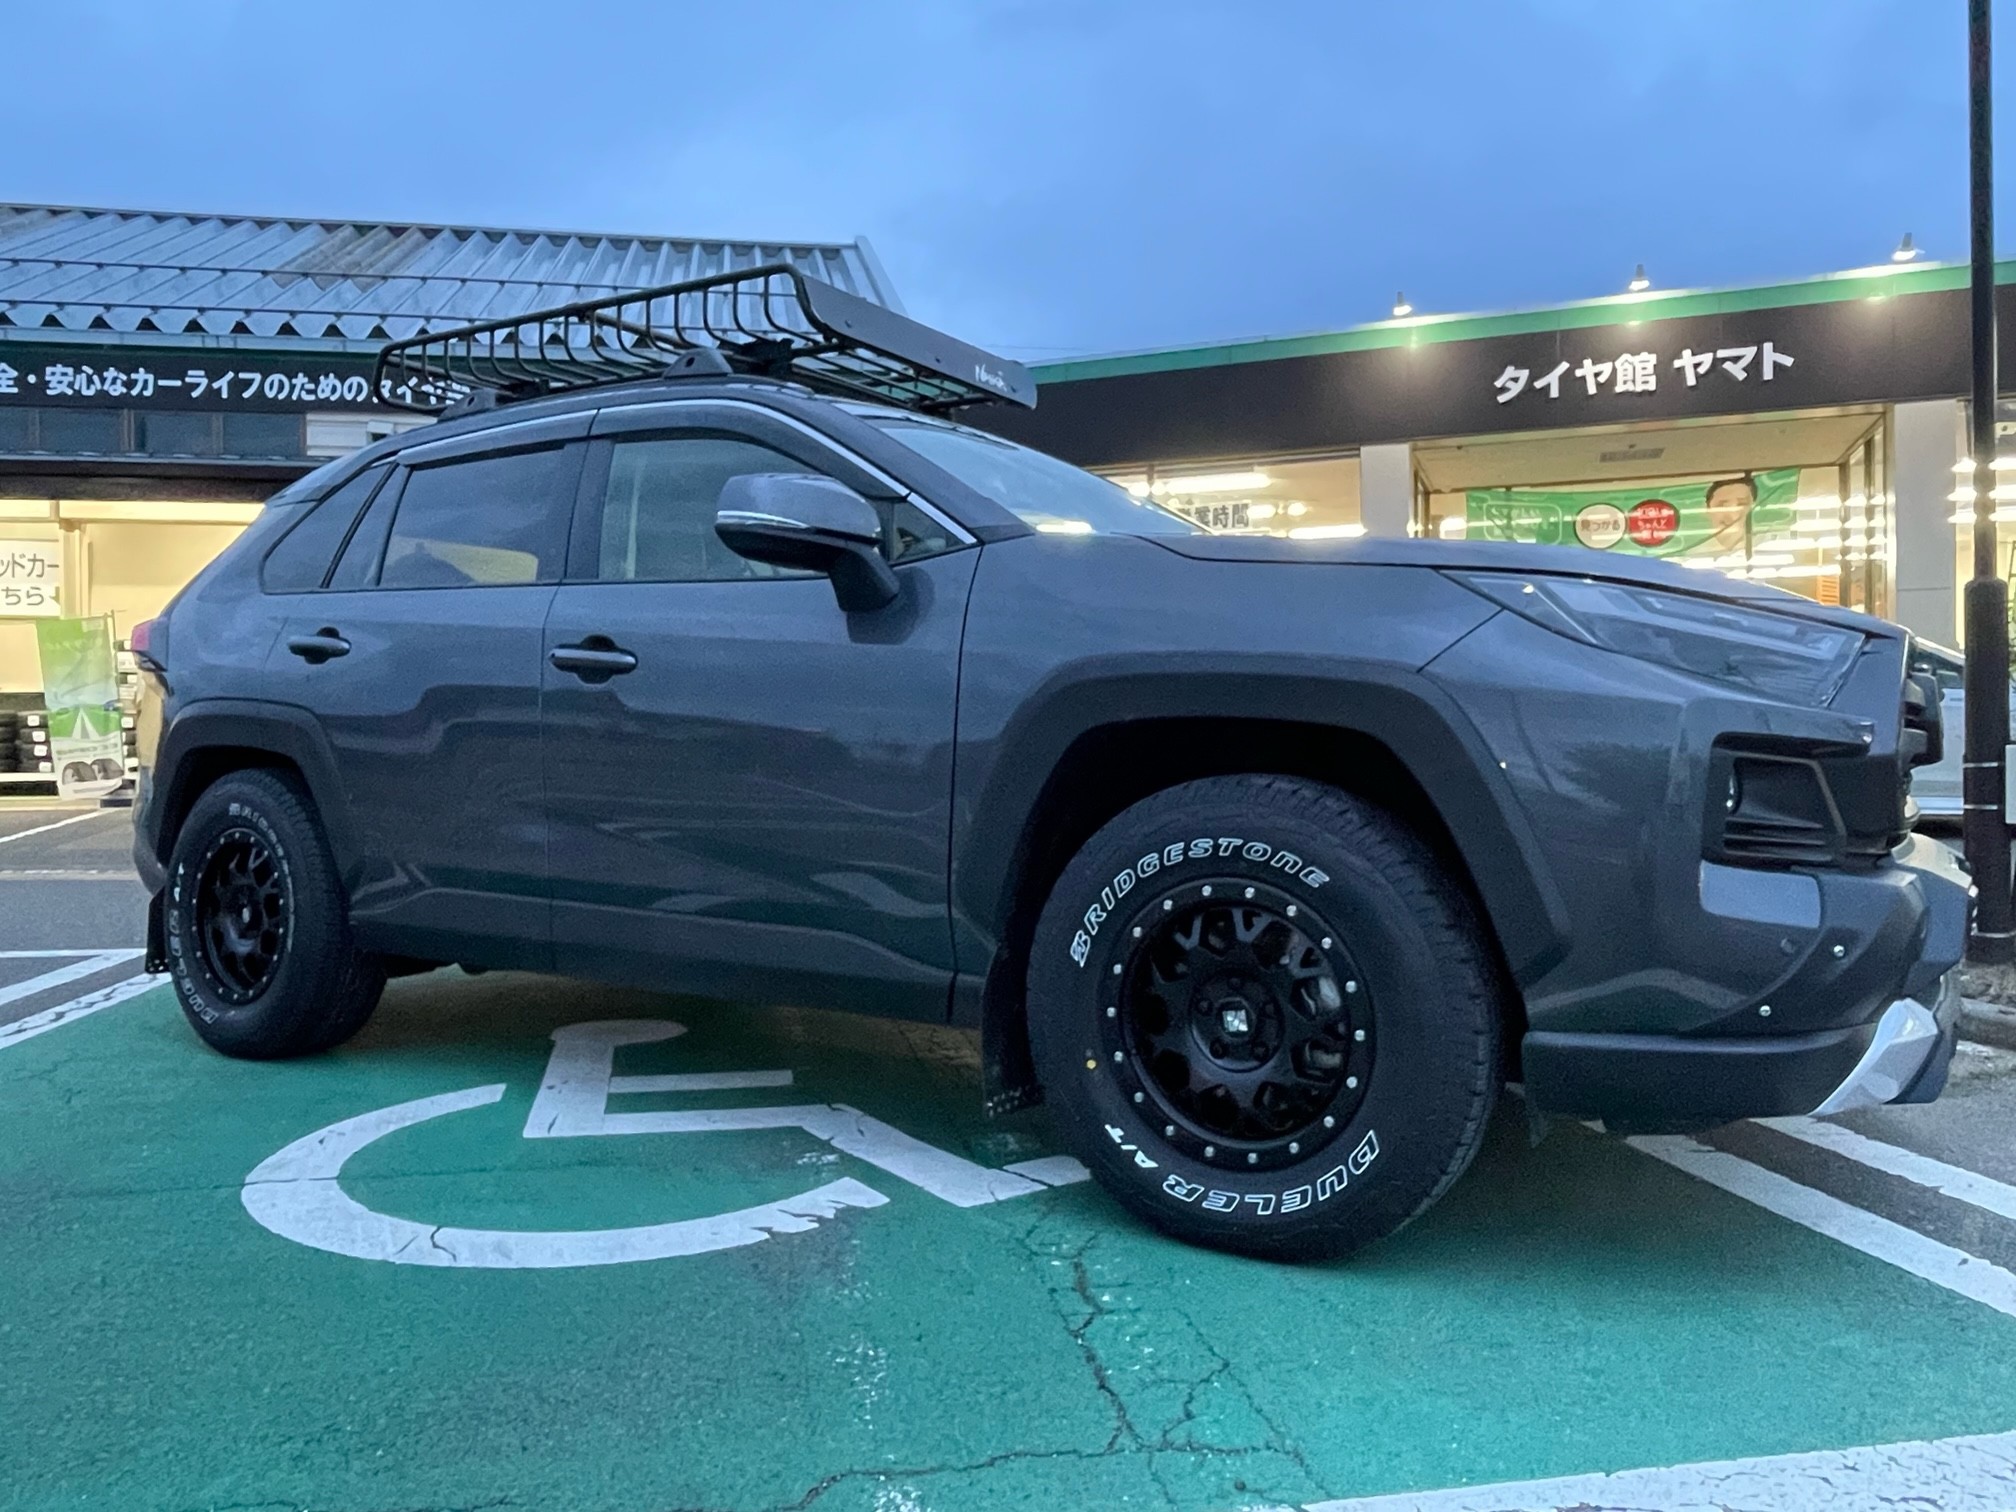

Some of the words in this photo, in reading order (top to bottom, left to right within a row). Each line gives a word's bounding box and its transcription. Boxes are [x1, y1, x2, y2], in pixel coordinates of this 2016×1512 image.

[1494, 351, 1657, 404] タイヤ館
[1673, 341, 1795, 387] ヤマト
[1070, 837, 1330, 968] BRIDGESTONE
[1104, 1124, 1159, 1169] A/T
[1162, 1129, 1380, 1216] DUELER
